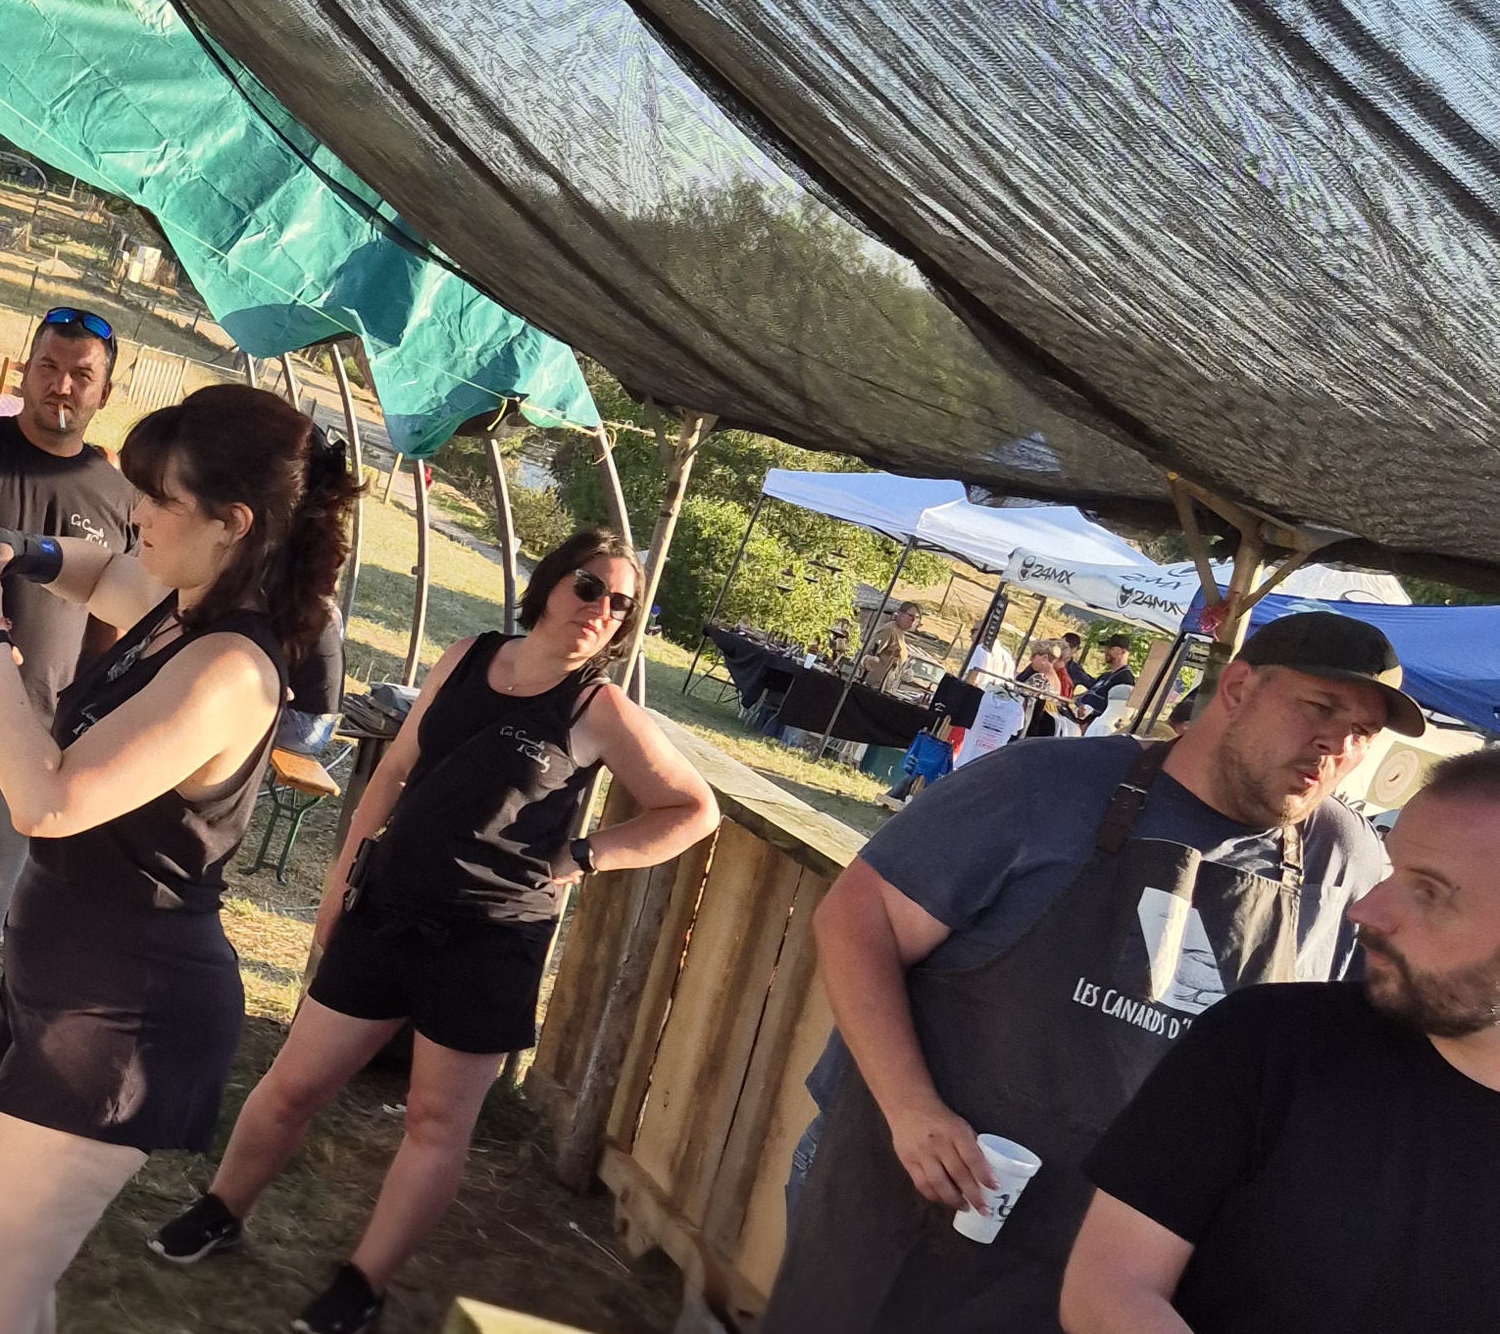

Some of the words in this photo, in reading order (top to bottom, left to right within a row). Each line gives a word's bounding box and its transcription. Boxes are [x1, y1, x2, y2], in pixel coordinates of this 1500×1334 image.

[1031, 564, 1076, 585] 24MX
[1133, 589, 1179, 615] 24MX
[1072, 977, 1102, 1007] LES
[1101, 989, 1168, 1035] CANARDS
